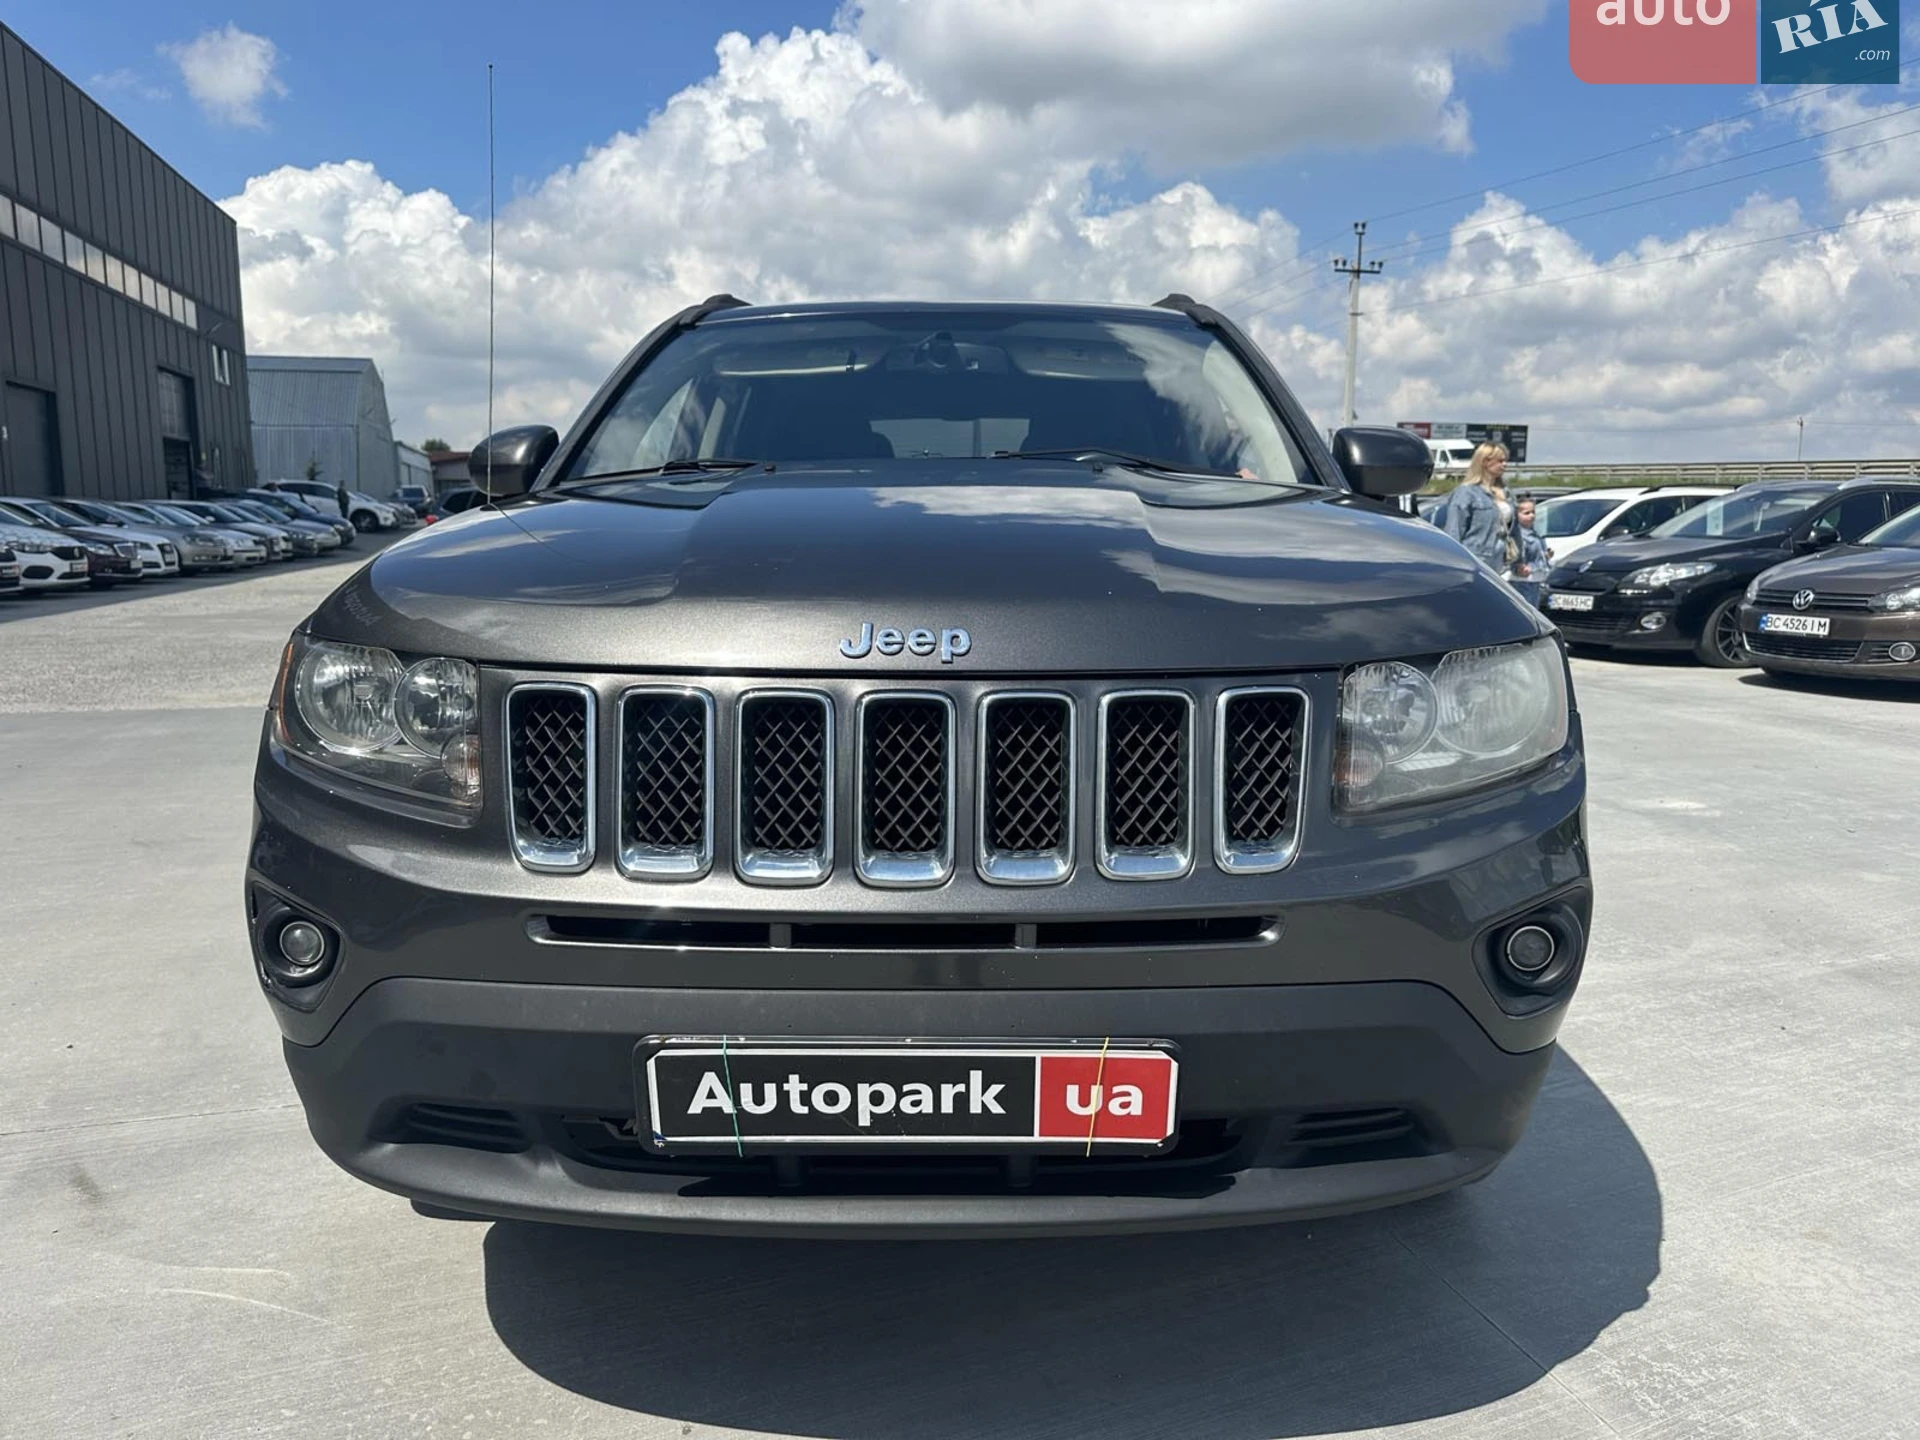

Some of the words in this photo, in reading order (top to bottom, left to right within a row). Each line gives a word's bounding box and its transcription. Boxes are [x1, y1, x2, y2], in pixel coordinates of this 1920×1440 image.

[840, 621, 971, 663] Jeep
[687, 1070, 1006, 1126] Autopark
[1065, 1083, 1144, 1116] ua
